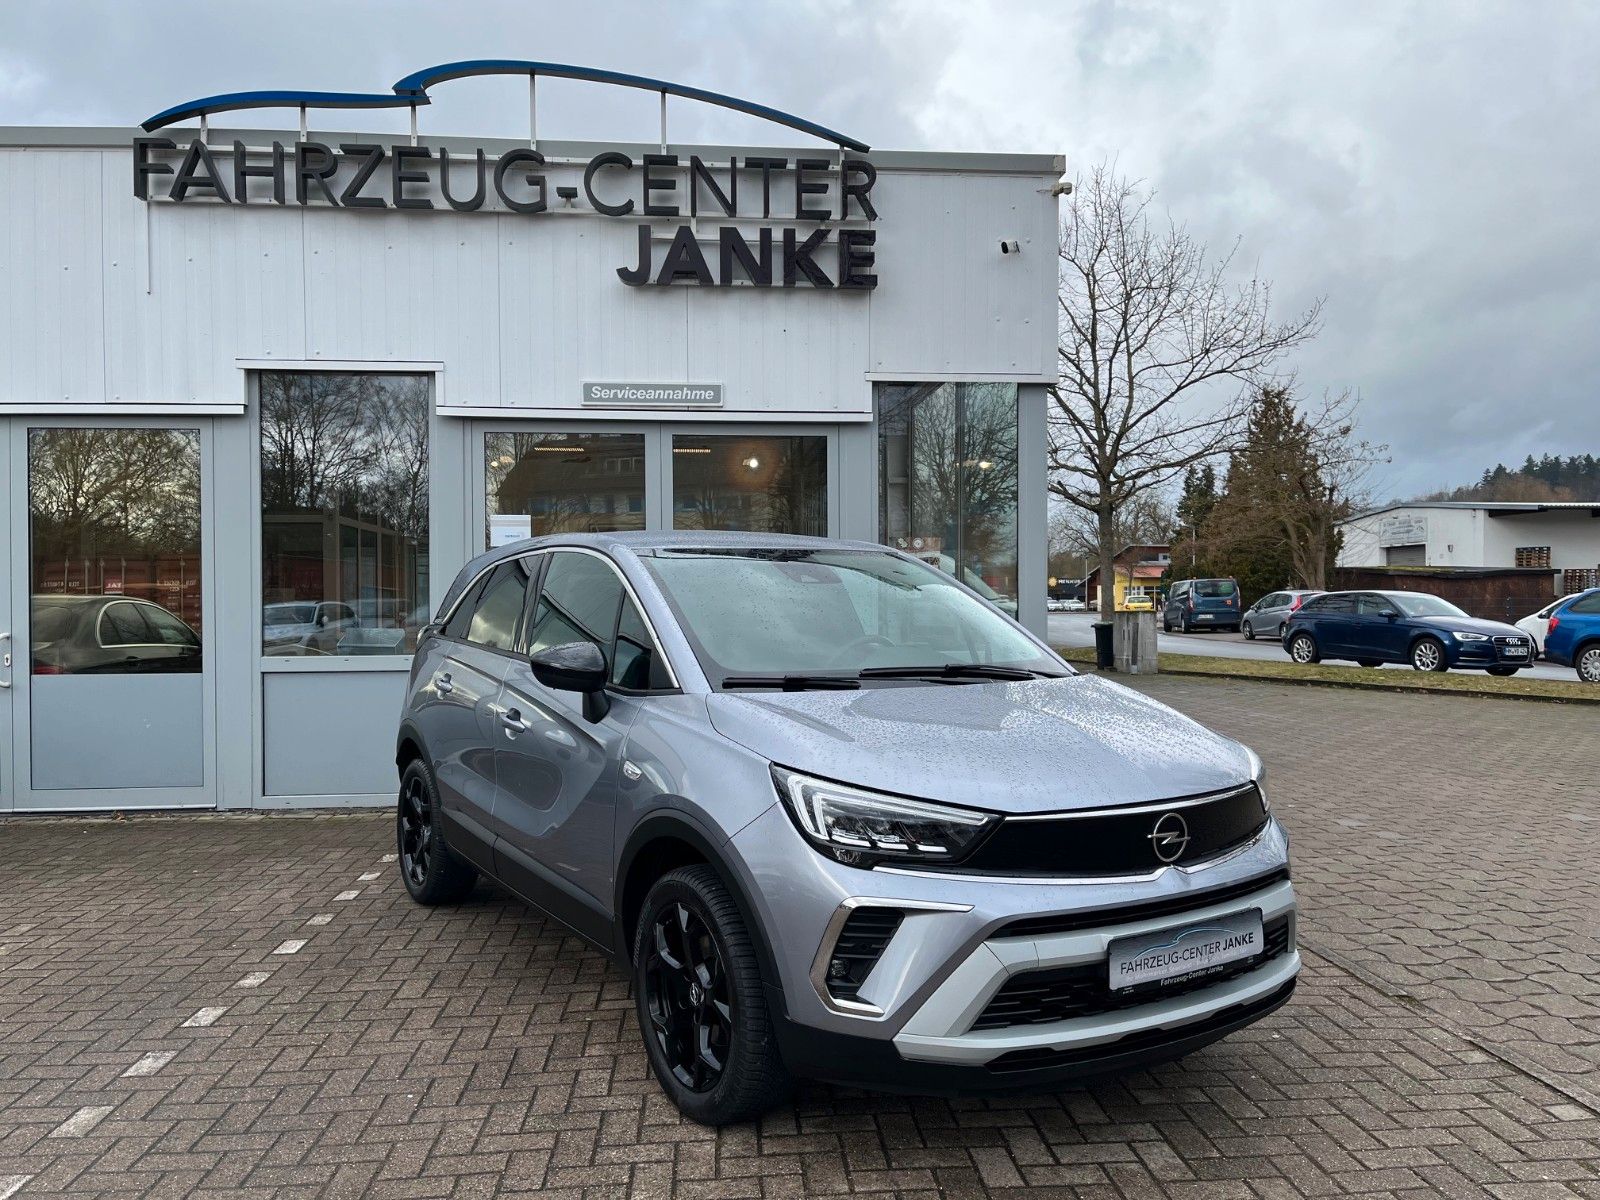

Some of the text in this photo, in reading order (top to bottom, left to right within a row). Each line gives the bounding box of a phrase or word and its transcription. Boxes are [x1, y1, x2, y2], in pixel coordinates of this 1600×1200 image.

[133, 137, 878, 222] FAHRZEUG-CENTER
[615, 224, 878, 289] JANKE
[590, 385, 715, 401] Serviceannahme
[1120, 943, 1221, 975] FAHRZEUG-CENTER
[1222, 932, 1254, 951] JANKE
